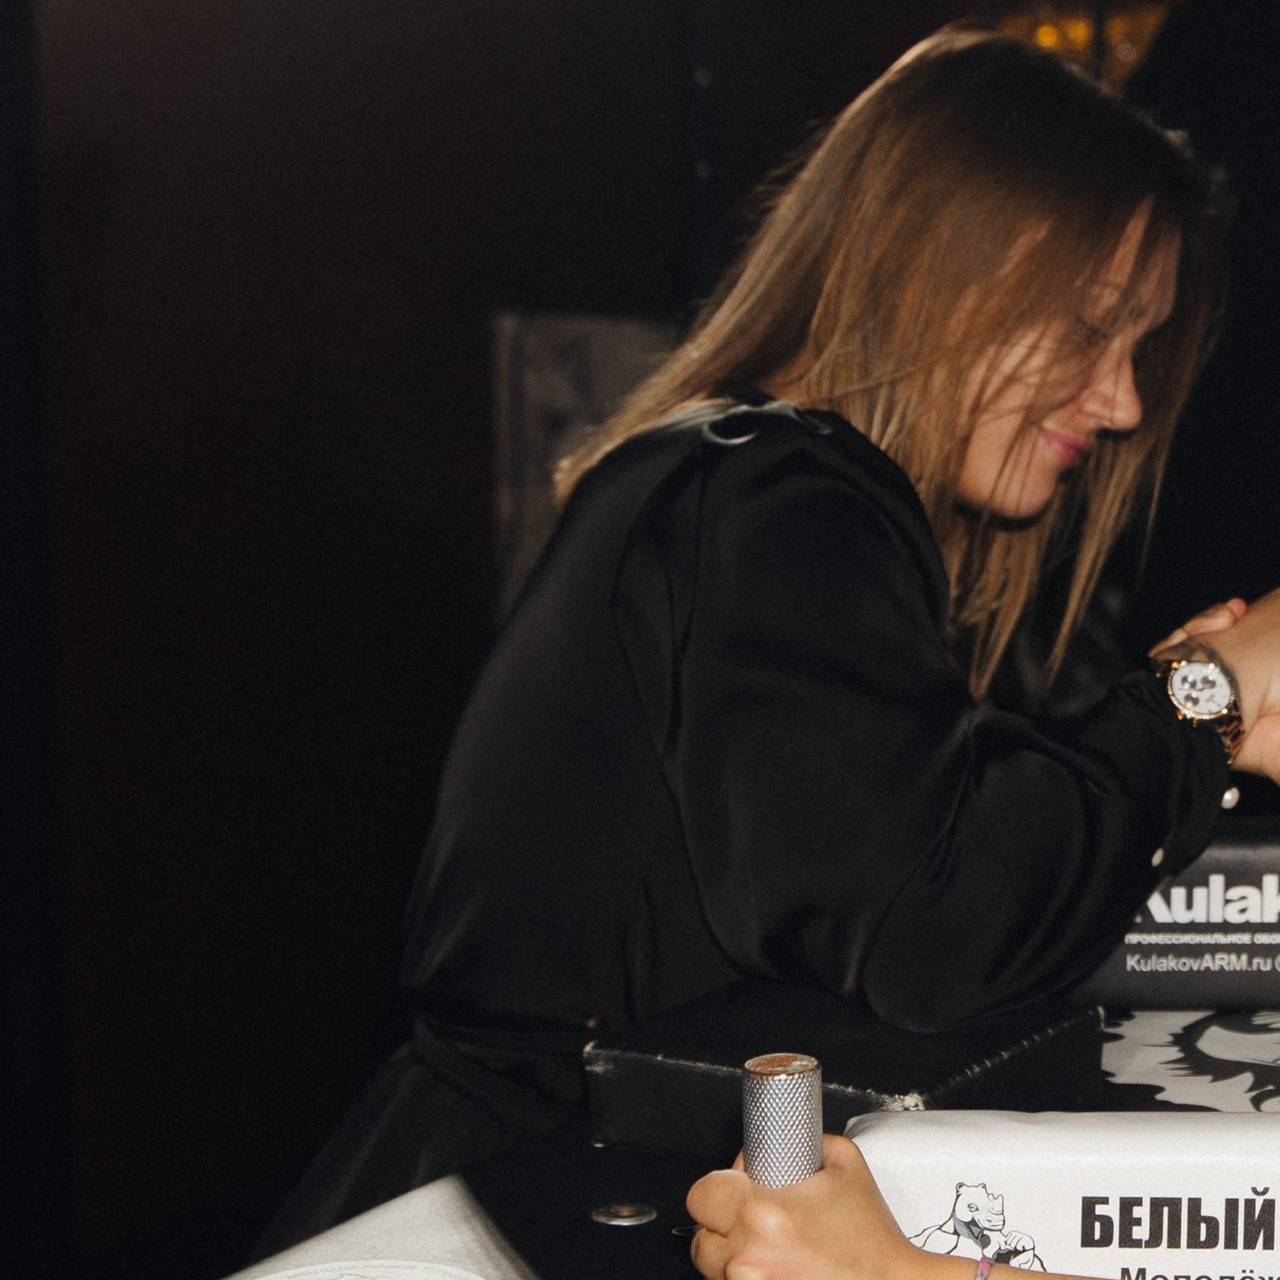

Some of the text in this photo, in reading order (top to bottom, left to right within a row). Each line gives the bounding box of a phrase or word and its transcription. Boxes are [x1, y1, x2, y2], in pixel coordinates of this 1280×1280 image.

[1125, 932, 1252, 945] ПРОФЕССИОНАЛЬНОЕ
[1126, 952, 1273, 972] KulakovARM.ru
[1080, 1187, 1276, 1251] БЕЛЫЙ
